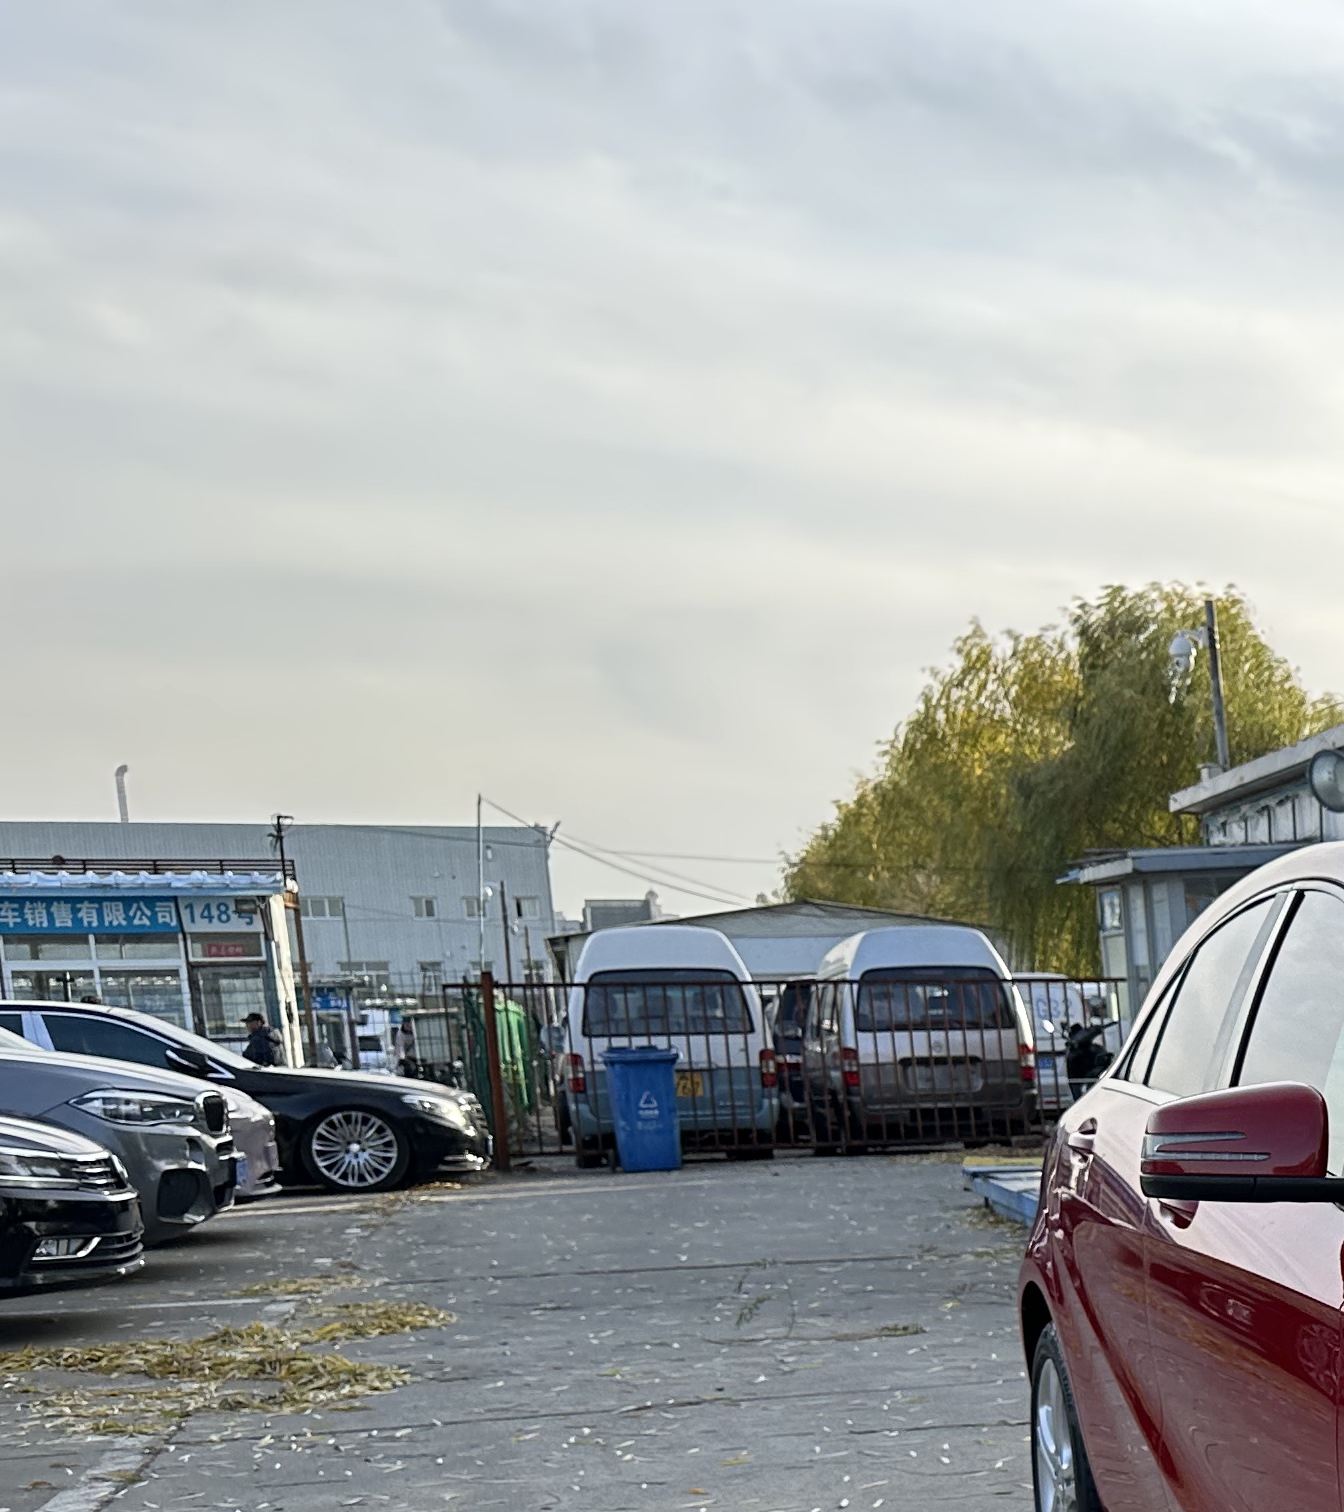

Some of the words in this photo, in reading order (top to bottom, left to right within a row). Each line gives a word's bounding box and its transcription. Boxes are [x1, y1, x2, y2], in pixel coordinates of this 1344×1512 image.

[0, 901, 178, 928] 车销售有限公司
